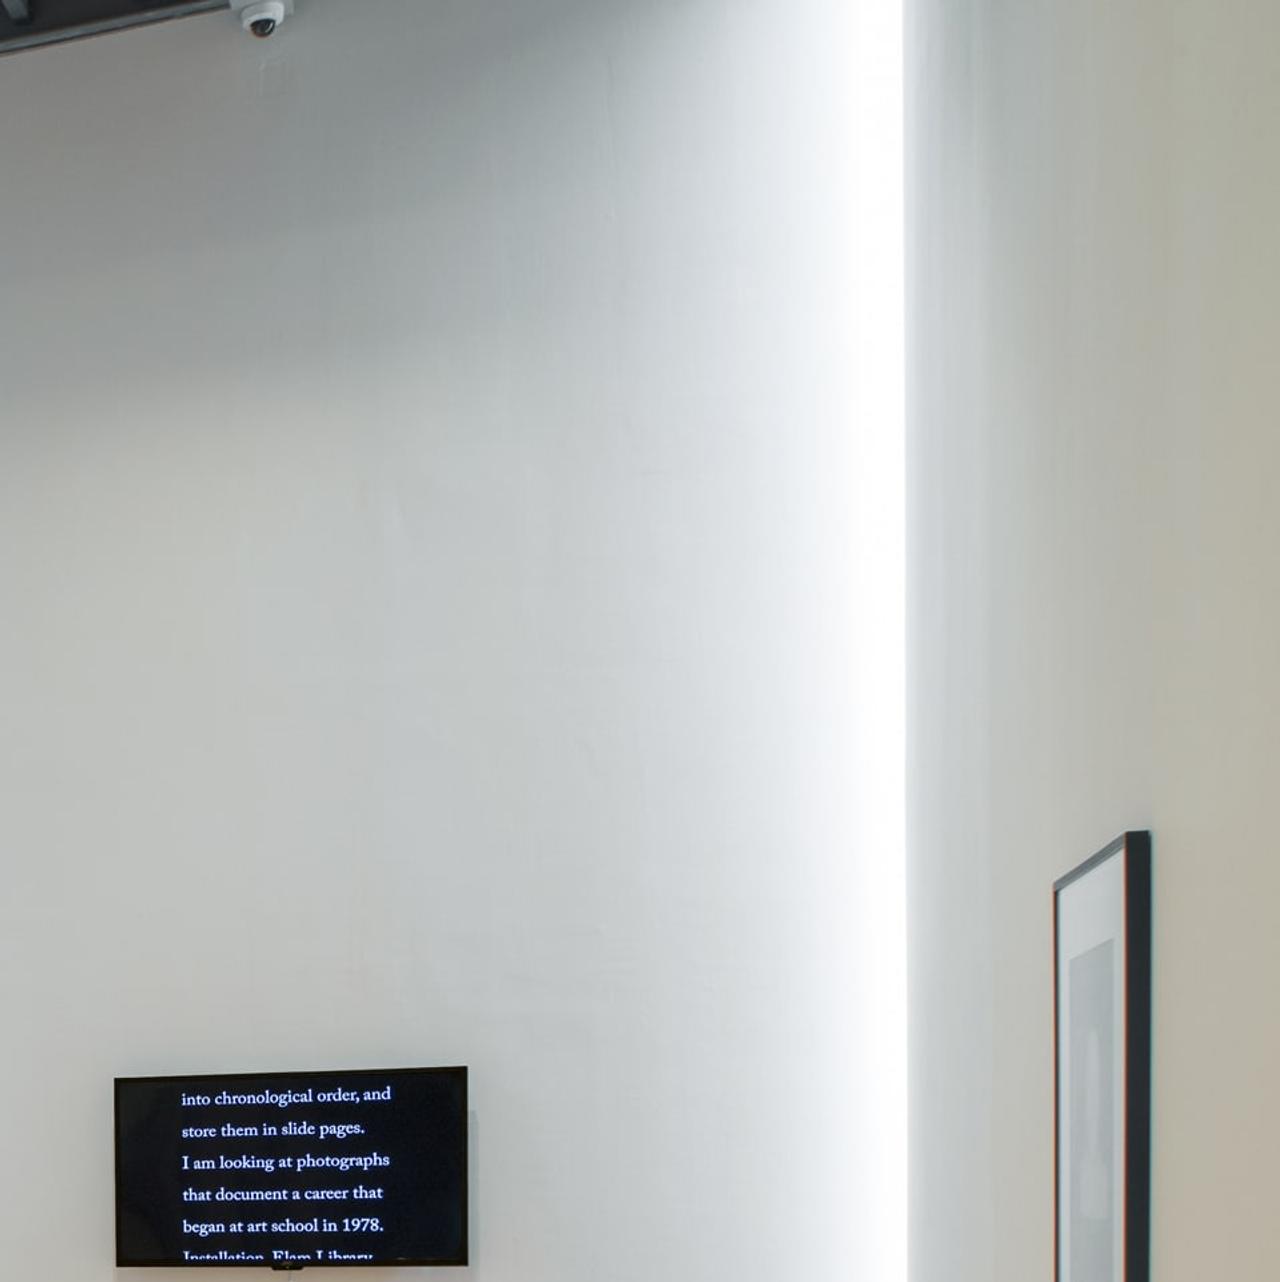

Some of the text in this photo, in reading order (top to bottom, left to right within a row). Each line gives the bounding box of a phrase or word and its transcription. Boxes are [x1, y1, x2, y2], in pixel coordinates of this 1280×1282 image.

[181, 1085, 392, 1108] into chronological order, and
[181, 1120, 366, 1140] store them in slide pages.
[181, 1151, 391, 1173] I am looking at photographs
[182, 1184, 384, 1202] that document a career that
[182, 1217, 384, 1238] began at art school in 1978.
